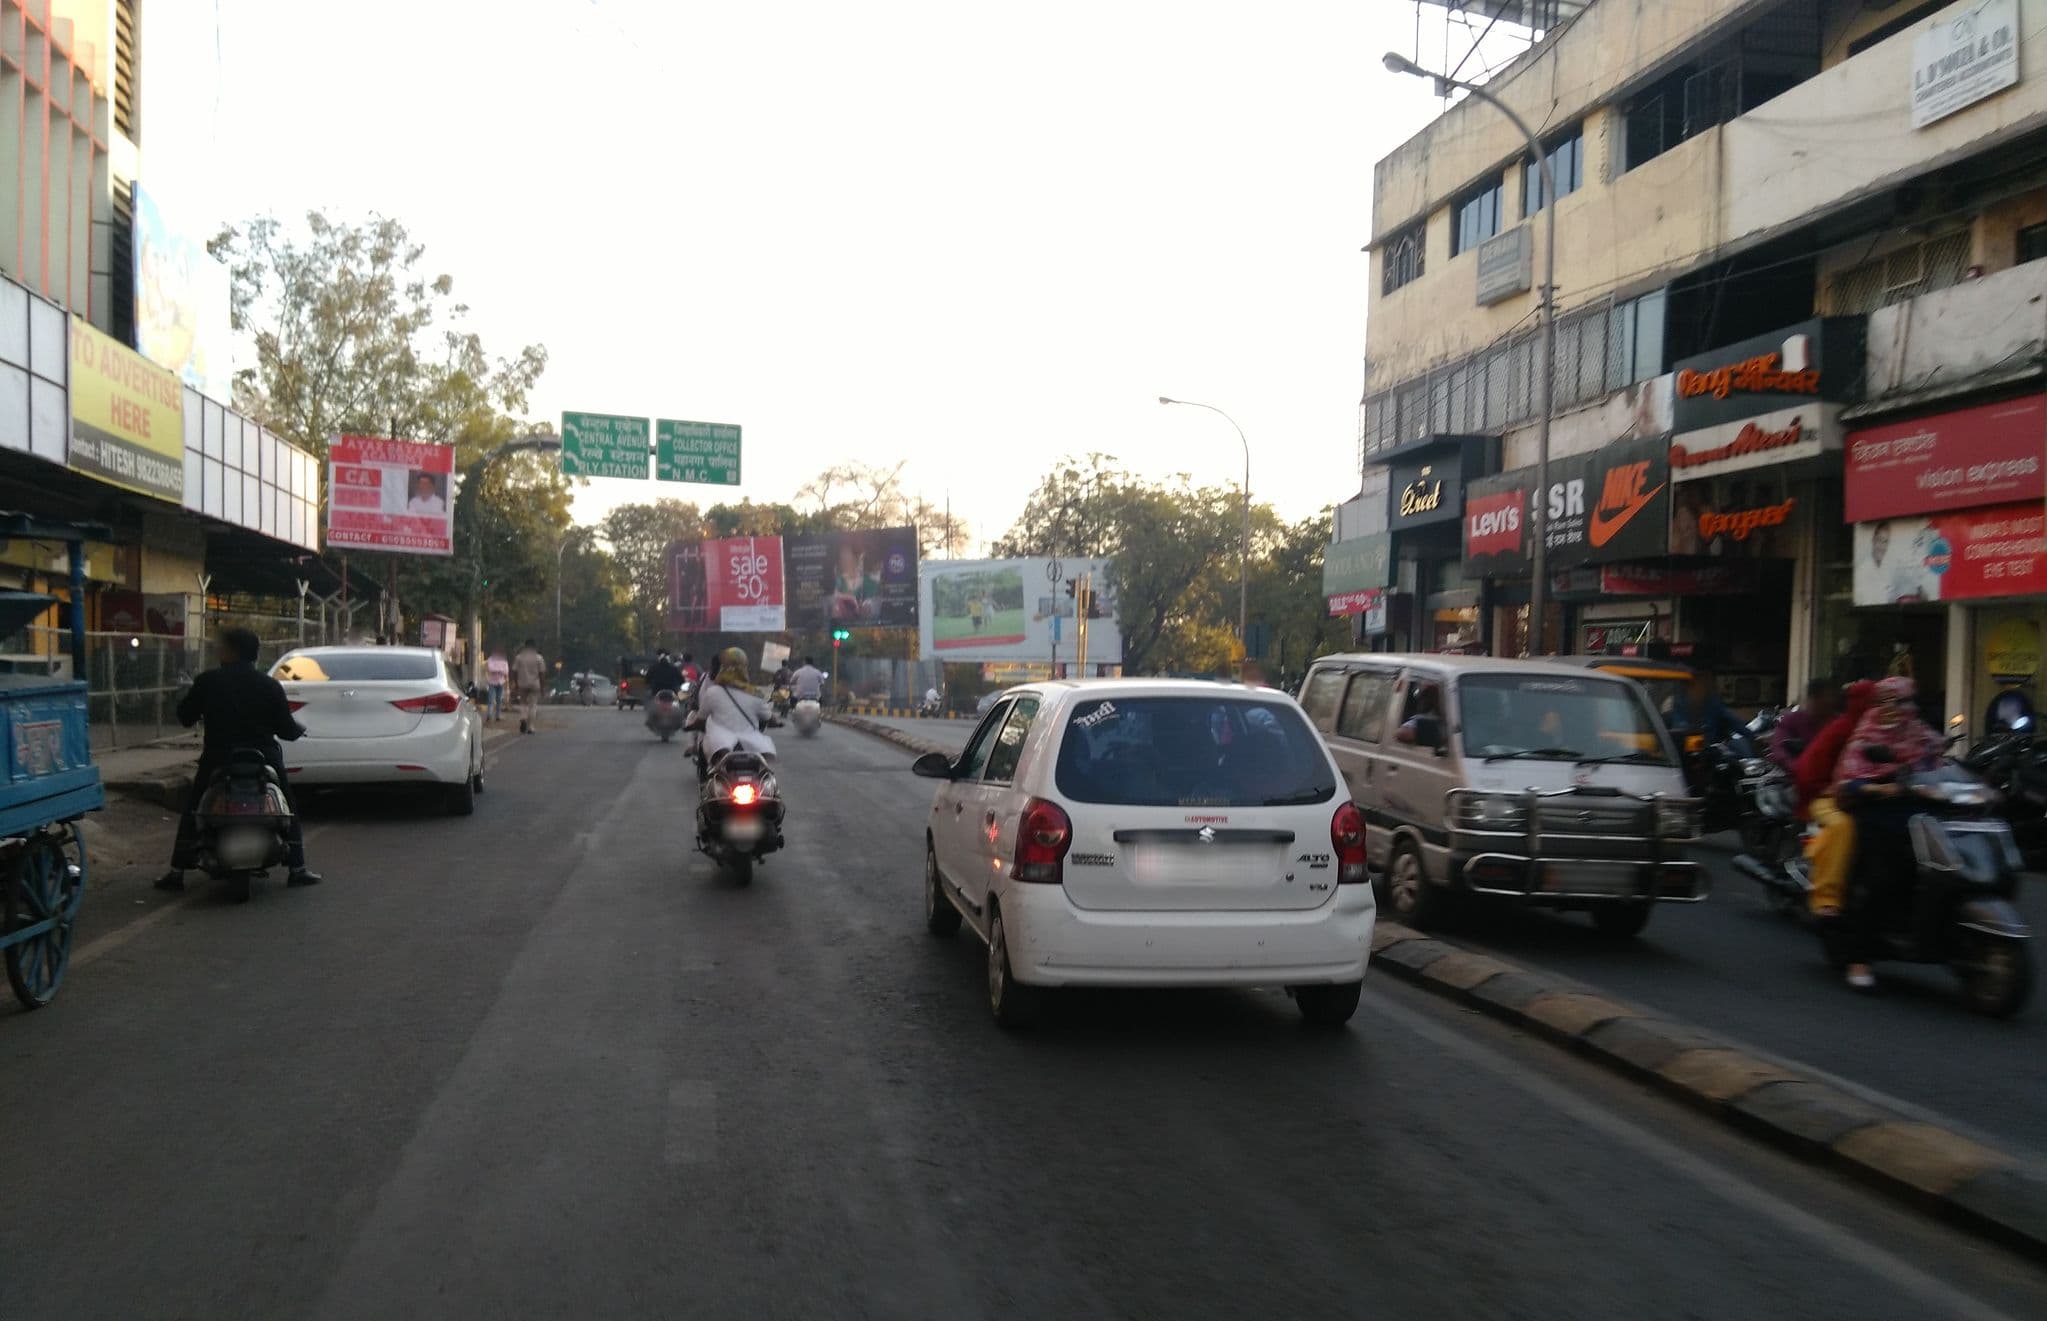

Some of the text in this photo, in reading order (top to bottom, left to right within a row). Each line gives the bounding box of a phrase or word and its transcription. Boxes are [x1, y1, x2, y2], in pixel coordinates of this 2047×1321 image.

[72, 330, 181, 412] TO ADVERTISE
[111, 392, 151, 438] HERE
[578, 432, 647, 448] CENTRAL AVENUE
[672, 438, 737, 454] COLLECTOR OFFICE
[101, 440, 135, 477] HITESH
[602, 463, 647, 478] STATION
[1967, 456, 2038, 484] express
[345, 470, 370, 485] CA
[1601, 459, 1652, 511] NIKE
[731, 550, 768, 576] sale
[1297, 854, 1330, 862] ALTO
